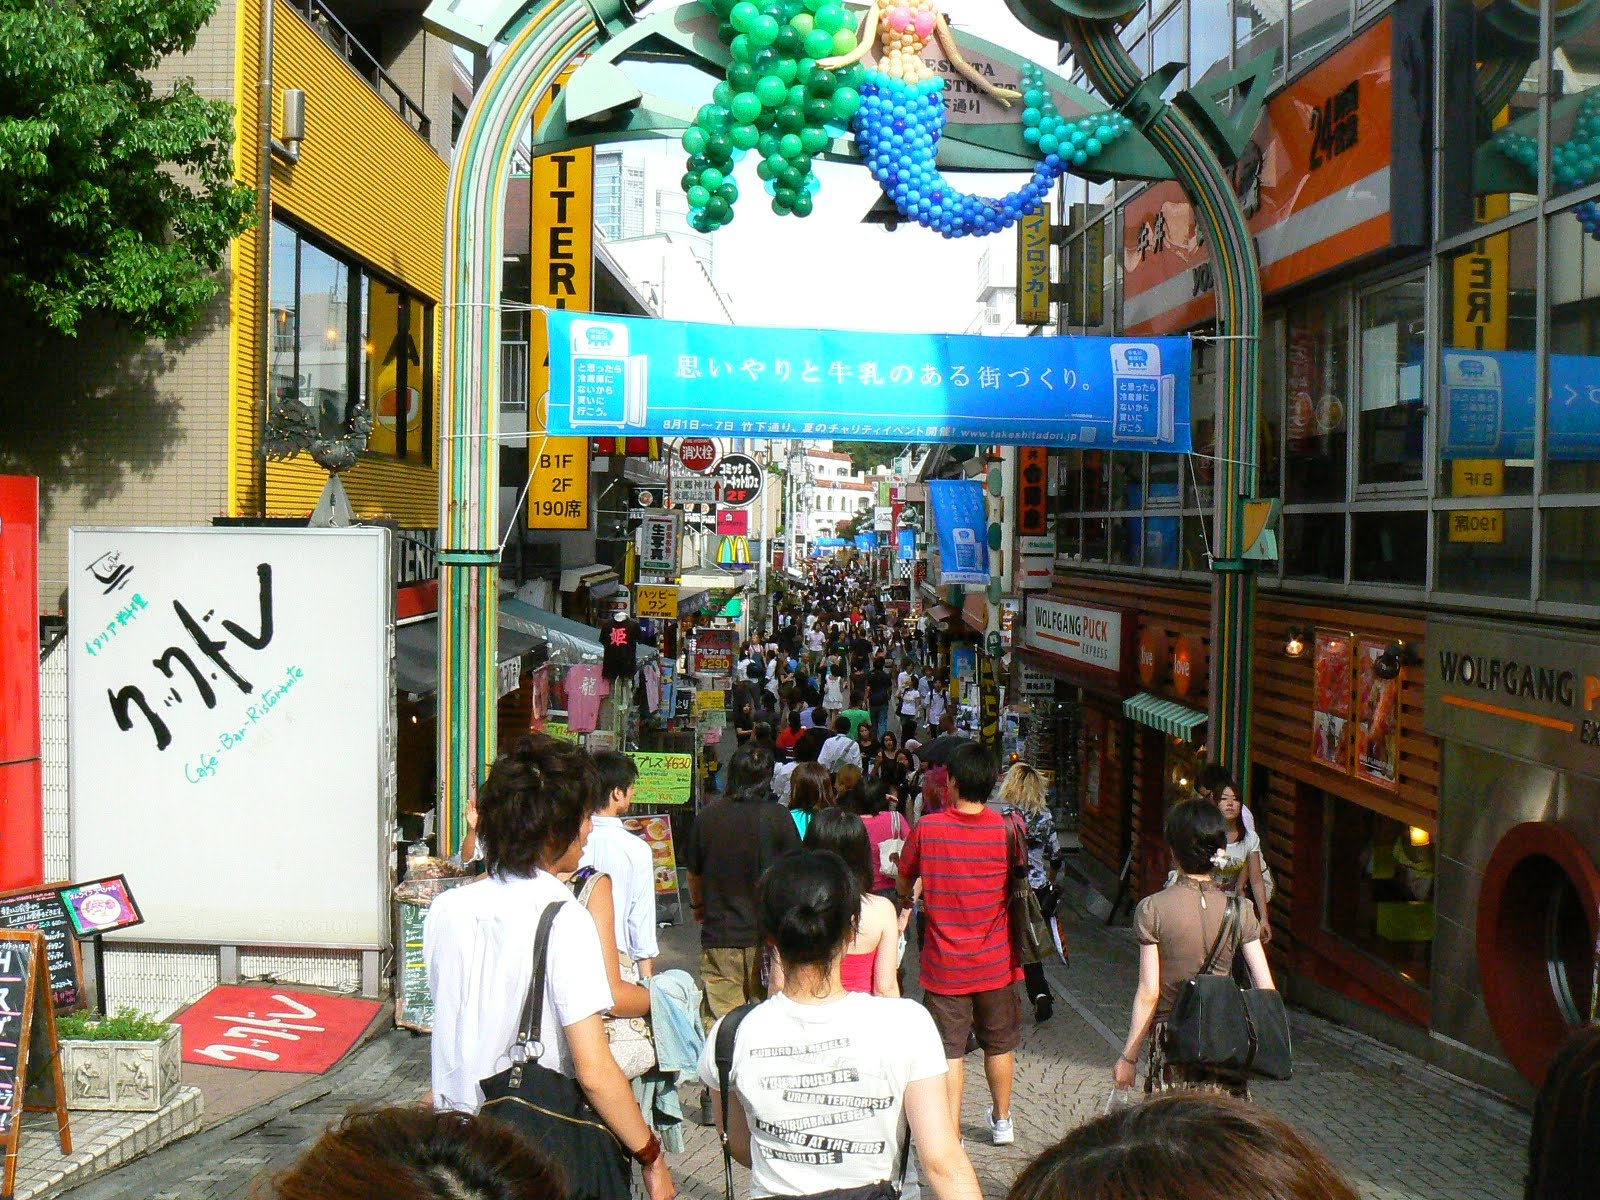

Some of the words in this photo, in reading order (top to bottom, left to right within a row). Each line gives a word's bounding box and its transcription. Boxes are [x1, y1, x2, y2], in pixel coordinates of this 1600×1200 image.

[676, 355, 1091, 391] 思いやりと牛乳のある街づくり。
[682, 445, 713, 460] 消火栓
[552, 479, 573, 492] 2F
[674, 480, 712, 490] 東郷神社
[727, 490, 748, 501] 2F
[534, 500, 582, 518] 190席
[638, 590, 677, 599] ハッピー
[648, 601, 668, 610] ワン
[1035, 606, 1081, 636] WOLFGANG
[1083, 617, 1108, 642] PUCK
[610, 627, 627, 646] 姫
[1082, 642, 1108, 660] EXPRESS
[1174, 653, 1190, 676] love
[1439, 650, 1576, 707] WOLFGANG
[788, 1073, 833, 1088] WOULD
[835, 1070, 851, 1082] BE
[787, 1091, 826, 1104] URBAN
[827, 1095, 890, 1110] TERRORISTS
[808, 1136, 825, 1149] AT
[827, 1138, 850, 1151] THE
[850, 1141, 882, 1153] REDS
[820, 1152, 836, 1163] BE
